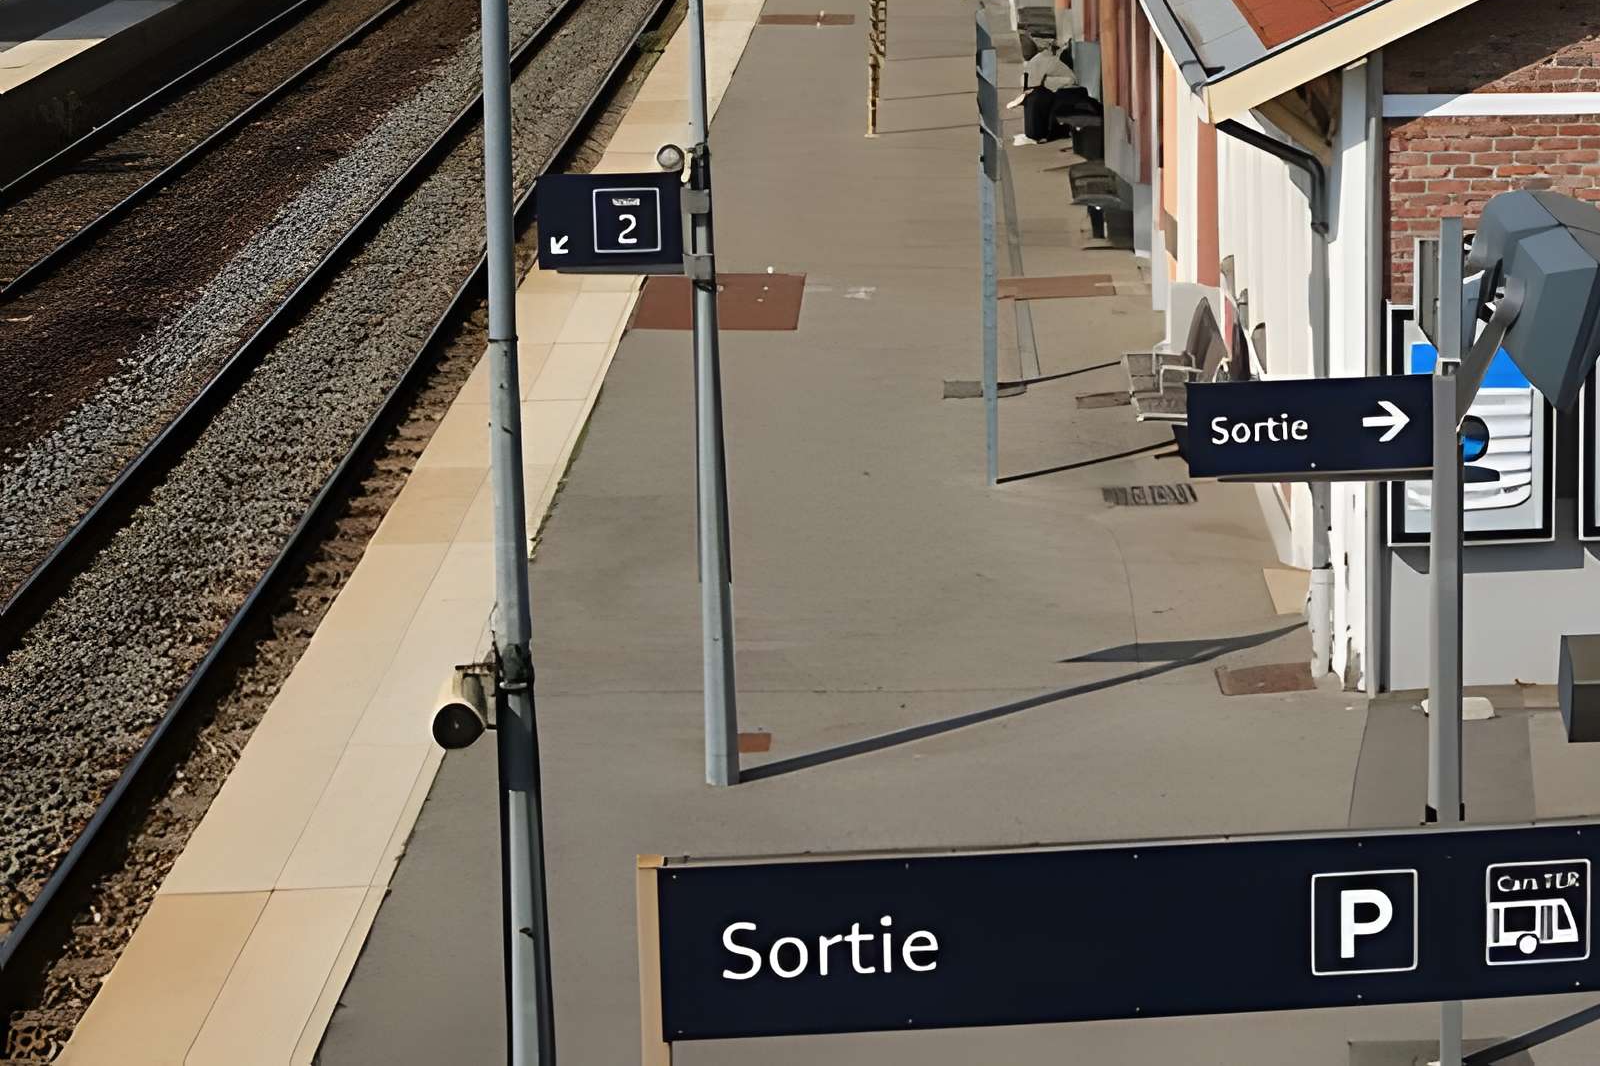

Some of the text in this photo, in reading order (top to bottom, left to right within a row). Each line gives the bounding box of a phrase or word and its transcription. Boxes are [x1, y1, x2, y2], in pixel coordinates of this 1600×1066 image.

[618, 214, 637, 244] 2
[1211, 413, 1308, 445] Sortie
[722, 915, 939, 980] Sortie
[1341, 889, 1393, 958] P
